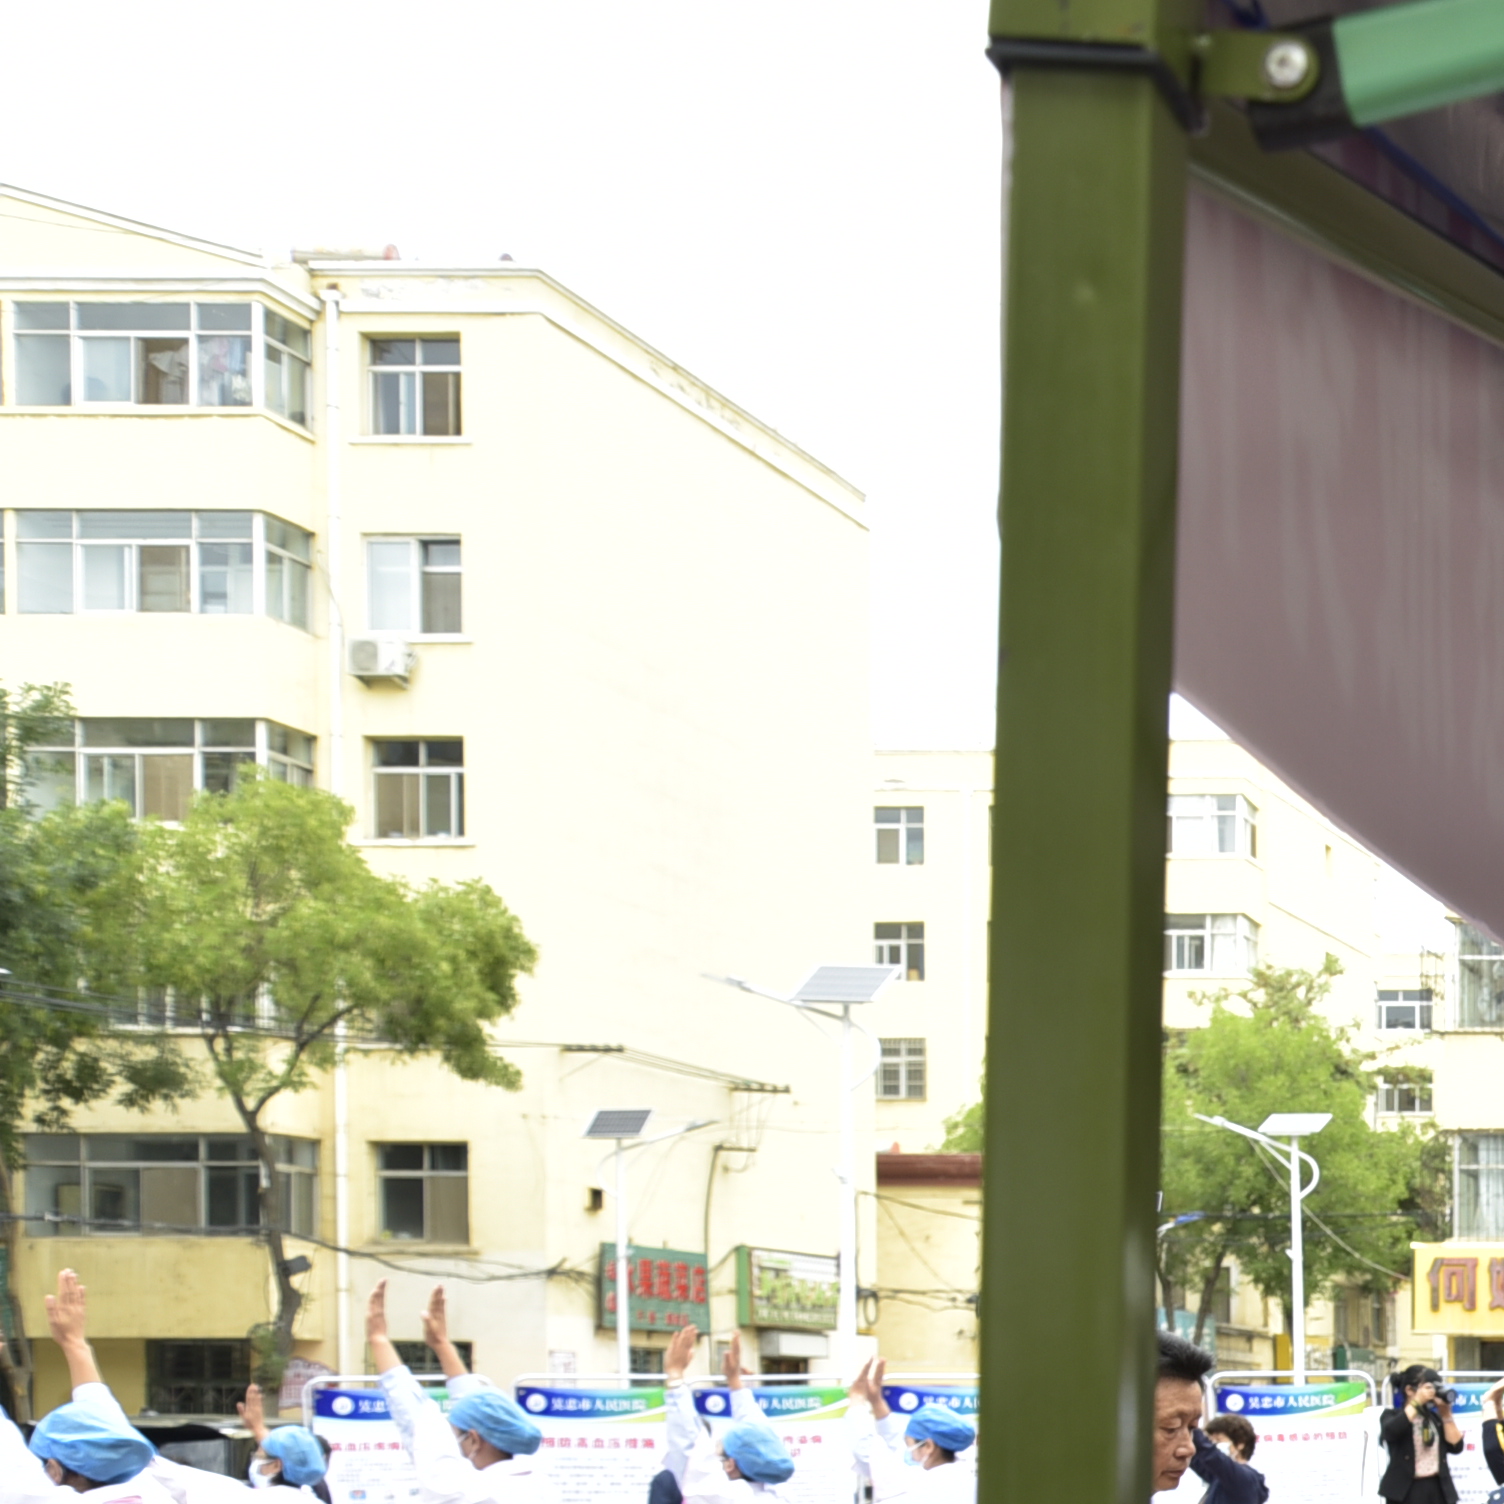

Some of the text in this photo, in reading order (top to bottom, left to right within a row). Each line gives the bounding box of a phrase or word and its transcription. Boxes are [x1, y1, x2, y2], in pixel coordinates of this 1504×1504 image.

[1249, 1395, 1336, 1409] 吴忠市人民医院
